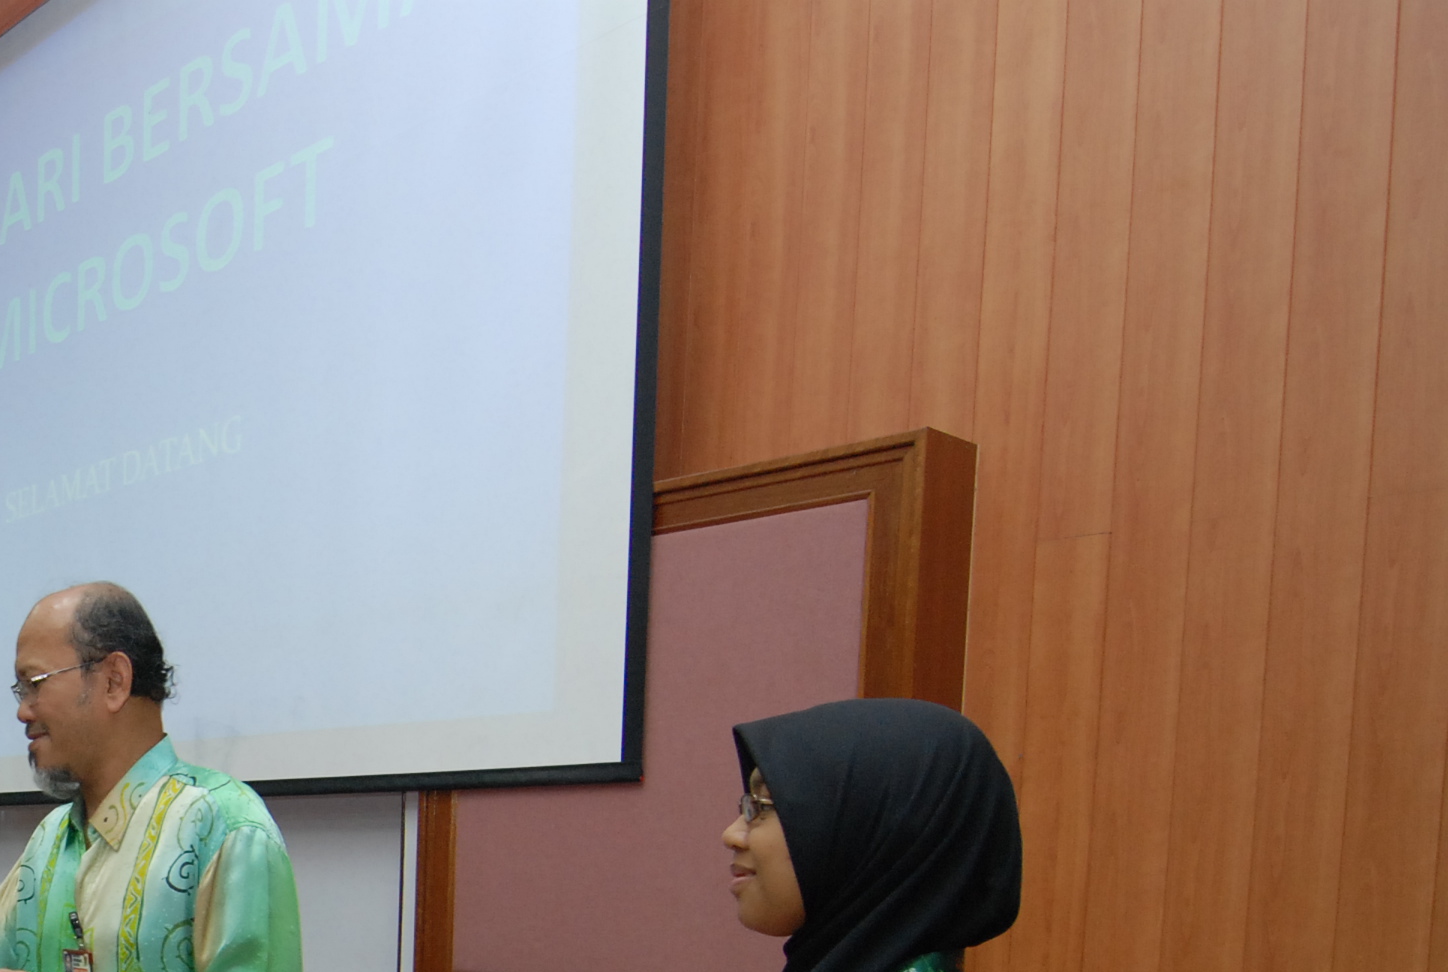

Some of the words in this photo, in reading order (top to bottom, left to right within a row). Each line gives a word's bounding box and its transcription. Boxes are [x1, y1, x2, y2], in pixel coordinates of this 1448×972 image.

[102, 0, 415, 184] BERSAM
[5, 457, 116, 524] SELAMAT
[122, 415, 244, 486] DATANG
